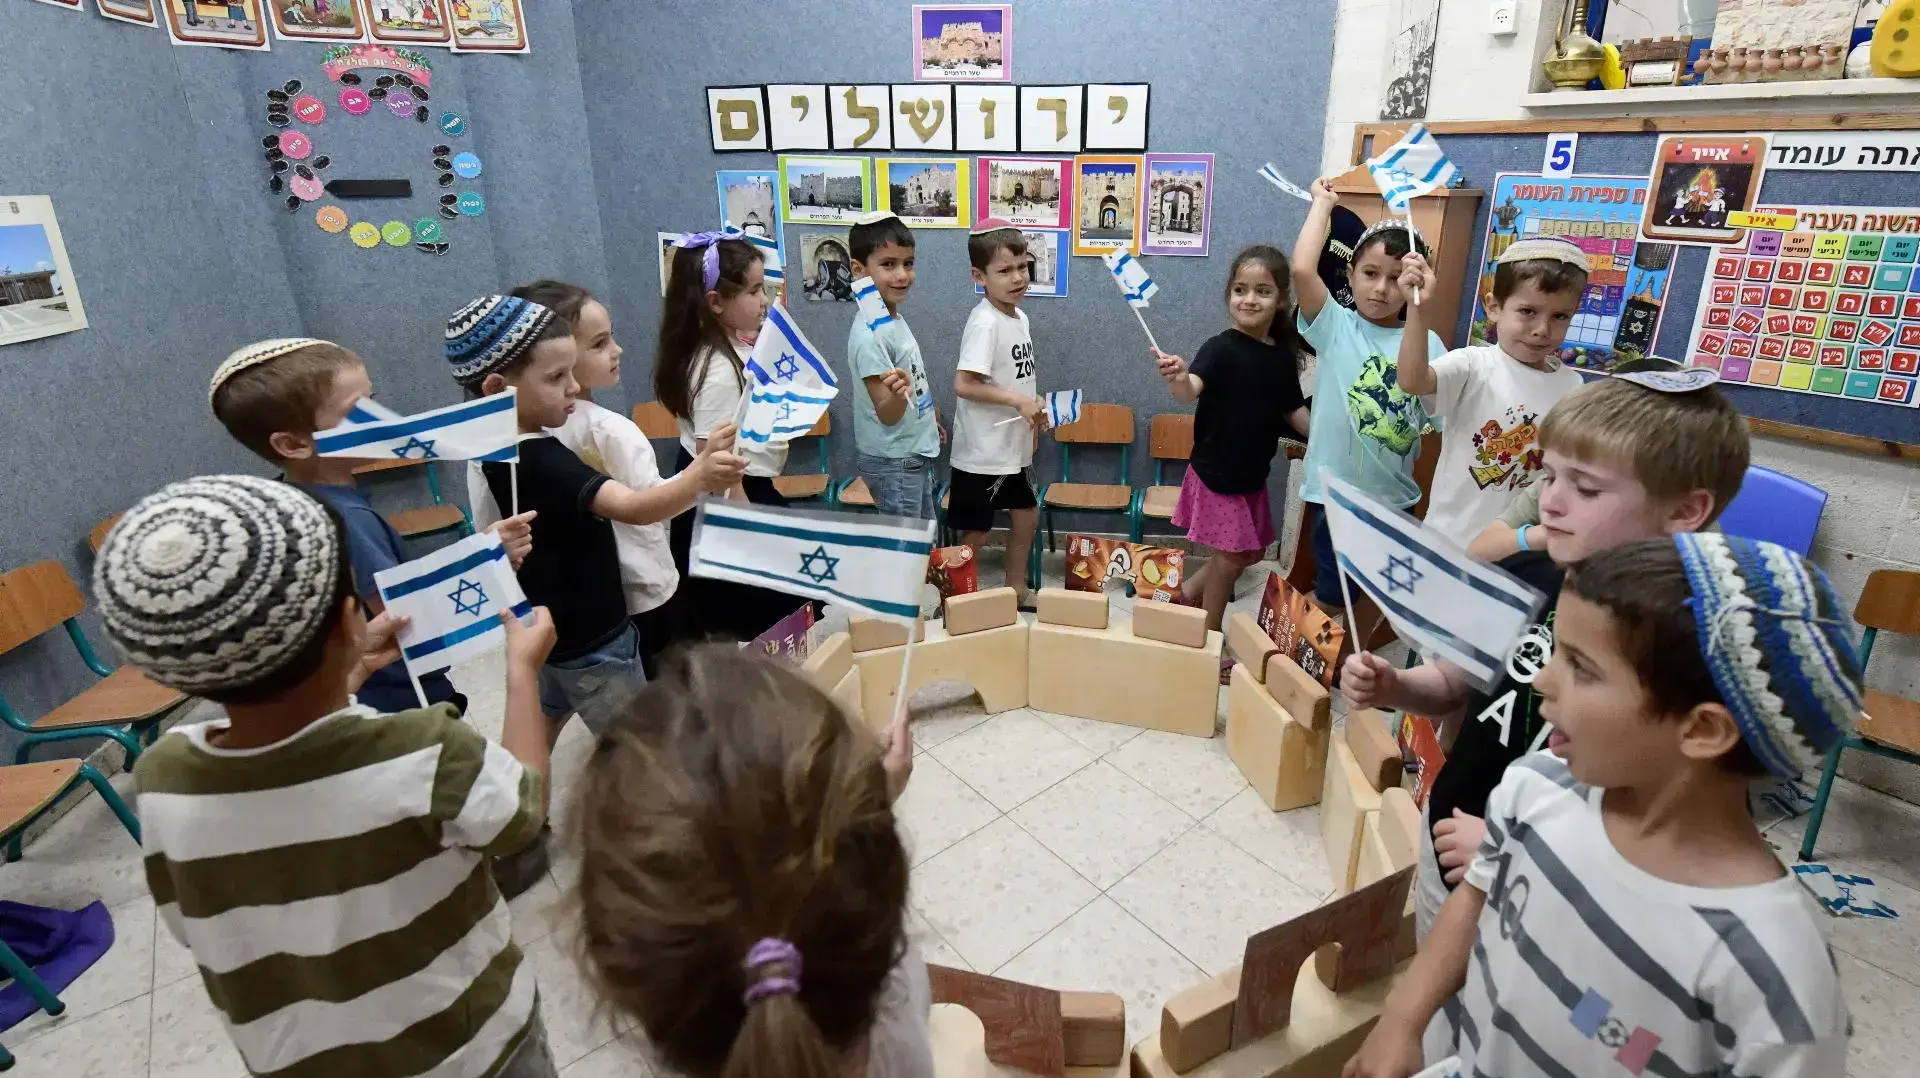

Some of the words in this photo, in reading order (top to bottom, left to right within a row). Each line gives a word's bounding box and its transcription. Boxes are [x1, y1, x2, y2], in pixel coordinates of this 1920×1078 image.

[716, 87, 1129, 147] ירושלים
[1549, 140, 1572, 172] 5
[1692, 147, 1730, 162] אייר
[1770, 146, 1846, 166] עומד
[1512, 184, 1564, 203] העומר
[1568, 187, 1630, 204] ספירת
[1747, 216, 1776, 226] אייר
[1800, 212, 1858, 232] העברי
[1722, 263, 1732, 272] ה
[1756, 265, 1765, 274] ד
[1786, 266, 1793, 276] ג
[1816, 267, 1825, 277] ב
[1850, 270, 1863, 280] א
[1810, 296, 1821, 305] ט
[1843, 298, 1855, 308] ח
[1881, 300, 1887, 310] ז
[1900, 355, 1909, 368] כ
